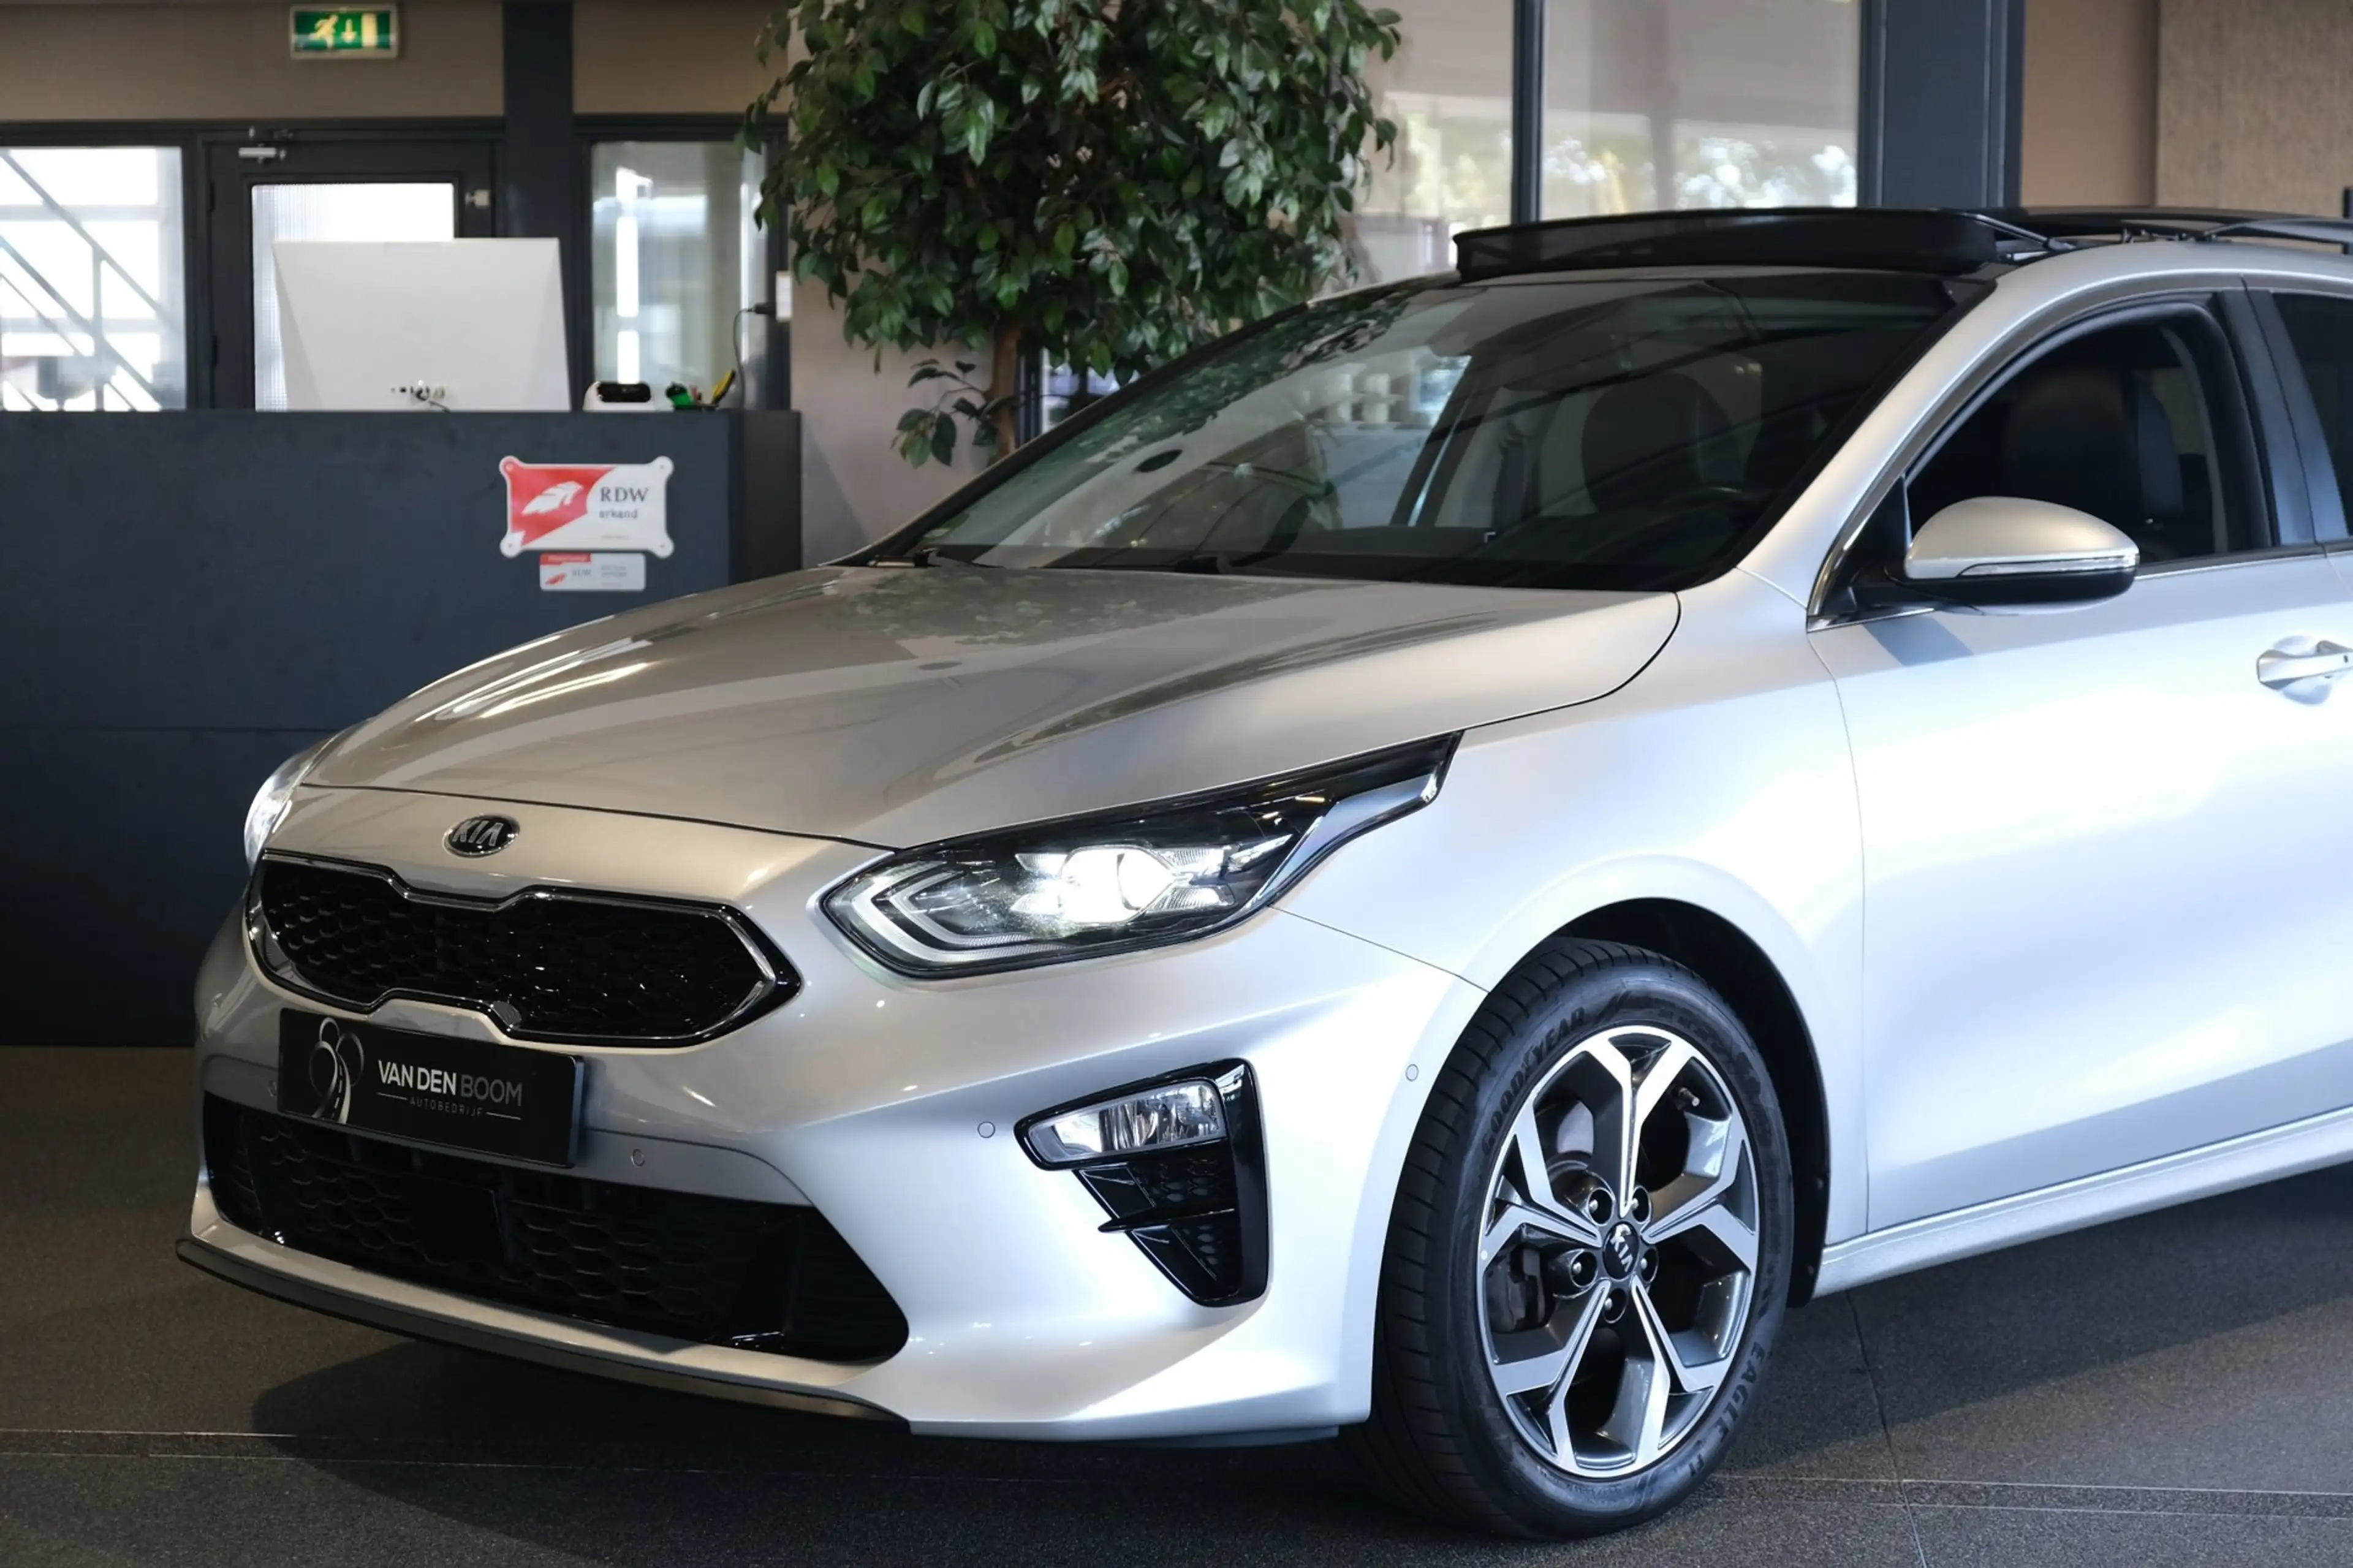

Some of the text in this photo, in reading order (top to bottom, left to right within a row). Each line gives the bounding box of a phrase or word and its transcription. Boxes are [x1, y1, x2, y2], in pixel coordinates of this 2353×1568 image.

[601, 486, 650, 502] RDW
[452, 820, 504, 847] KIA
[377, 1059, 523, 1107] VAN DEN BOOM
[1481, 1007, 1585, 1155] GOODYEAR
[409, 1097, 483, 1117] AUTOBEDRIJF
[1610, 1227, 1633, 1273] KIA
[1715, 1341, 1766, 1442] EAGLE
